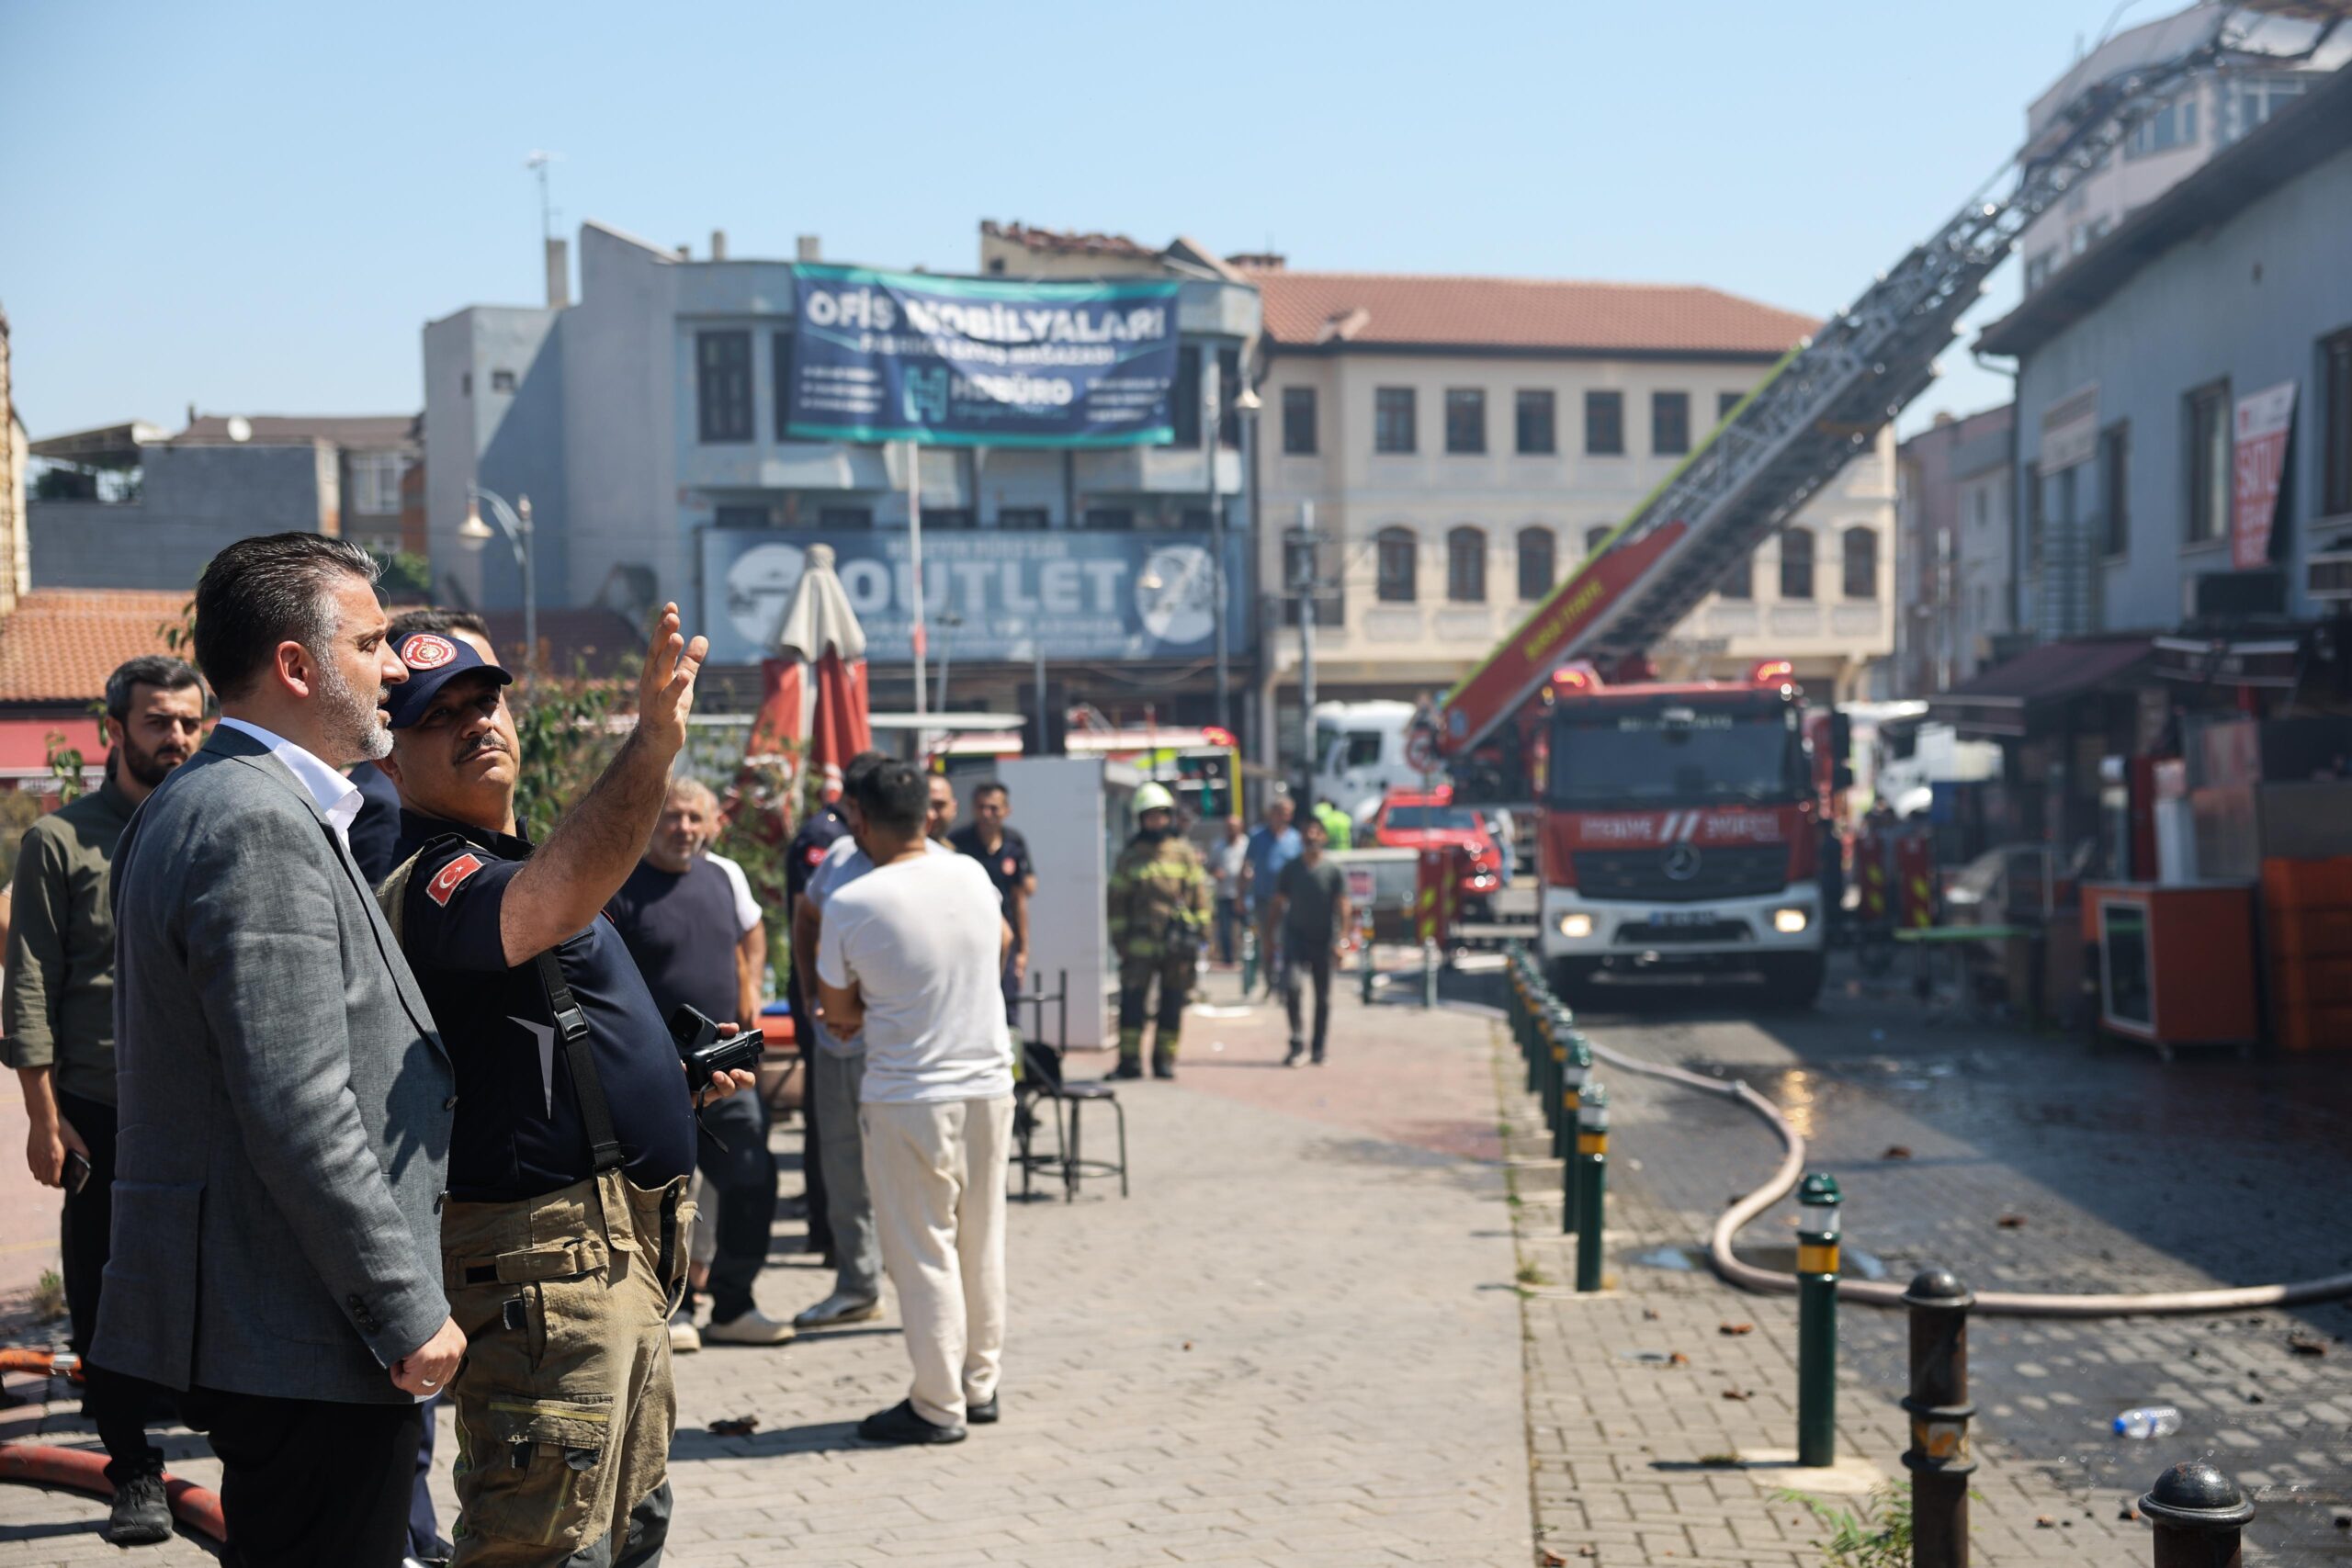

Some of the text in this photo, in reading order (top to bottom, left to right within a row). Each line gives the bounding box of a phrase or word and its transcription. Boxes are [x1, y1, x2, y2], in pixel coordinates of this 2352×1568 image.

[808, 289, 1165, 344] OFİS MOBİLYALARI
[841, 558, 1128, 614] OUTLET
